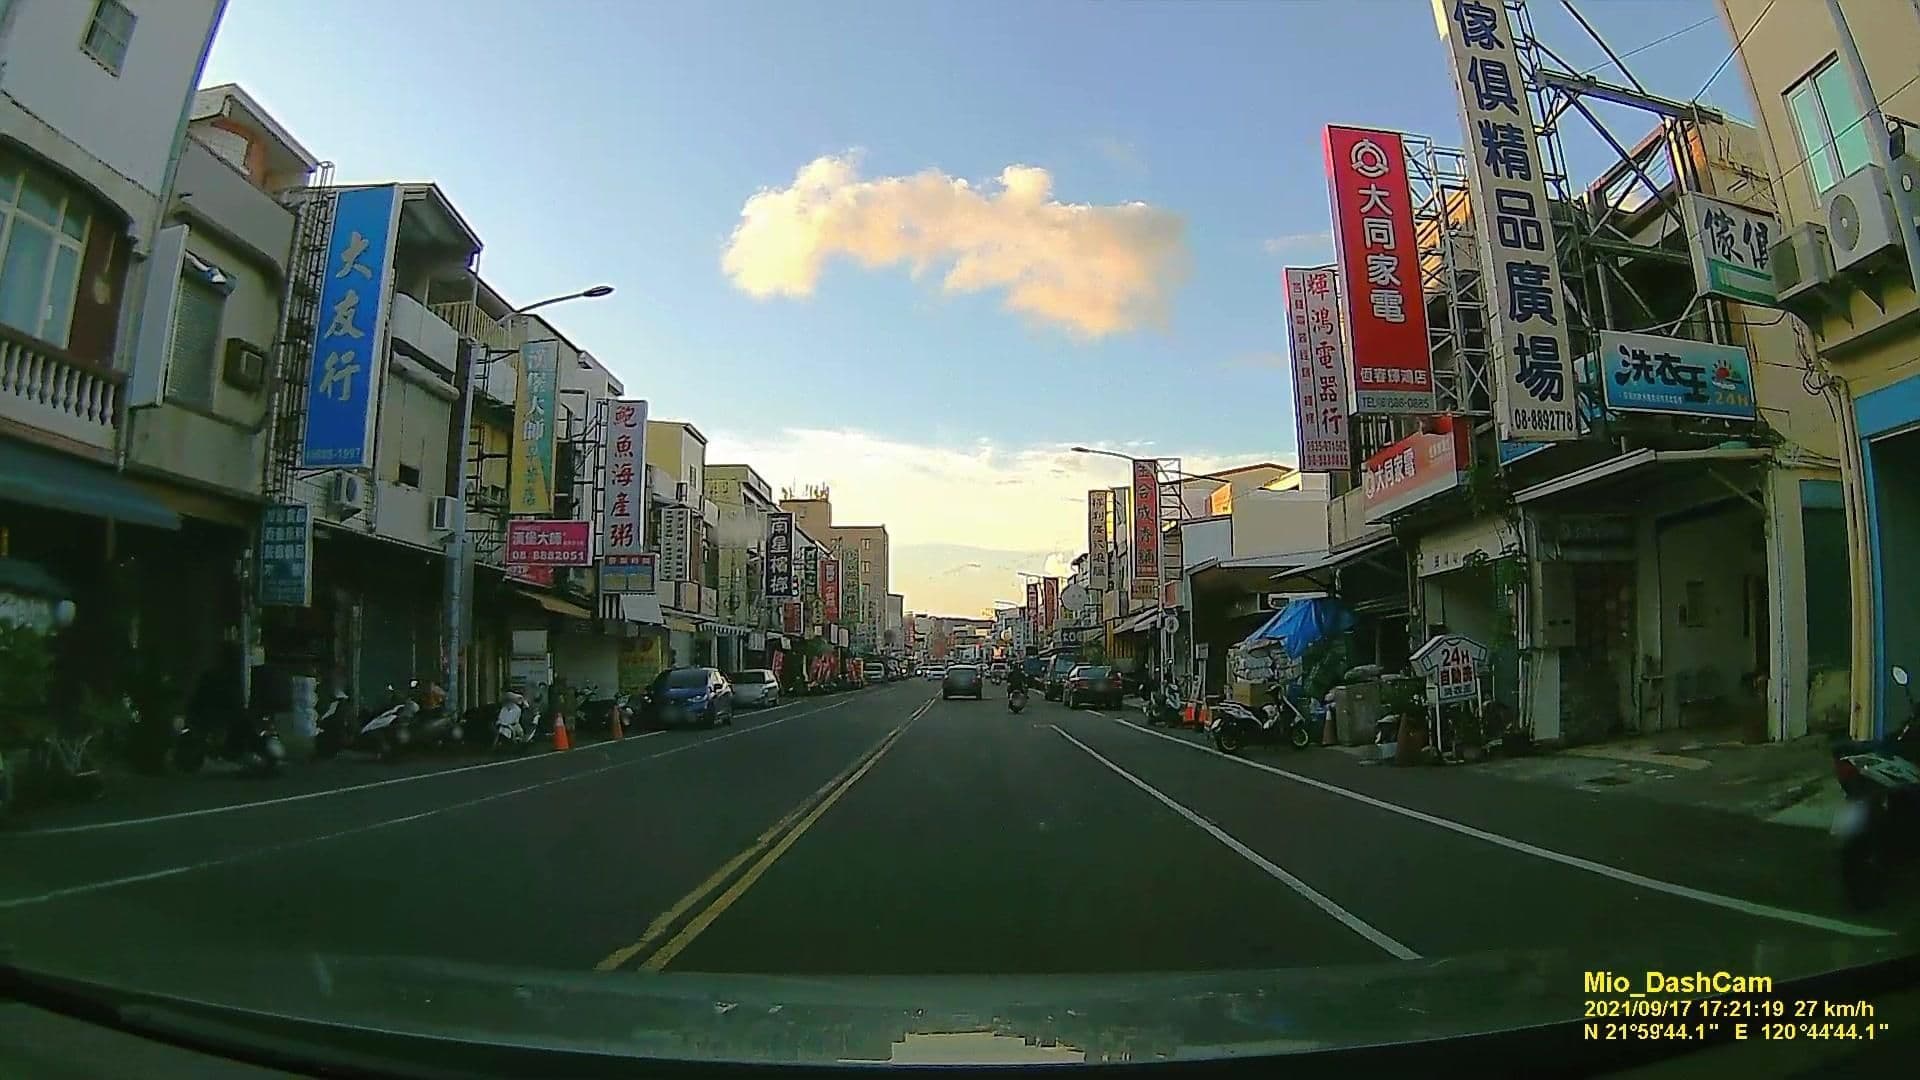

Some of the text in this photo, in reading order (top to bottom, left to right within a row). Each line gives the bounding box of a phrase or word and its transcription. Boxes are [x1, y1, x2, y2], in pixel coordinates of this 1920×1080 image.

[1358, 183, 1406, 323] 大同家電
[1453, 0, 1564, 403] 傢俱精品廣場
[319, 231, 374, 401] 大友行
[1306, 272, 1343, 435] 輝鴻電器行
[1614, 343, 1711, 404] 洗衣王
[610, 404, 638, 549] 鮑魚海產粥
[1513, 408, 1574, 433] 08-8892778
[1441, 646, 1470, 667] 24H
